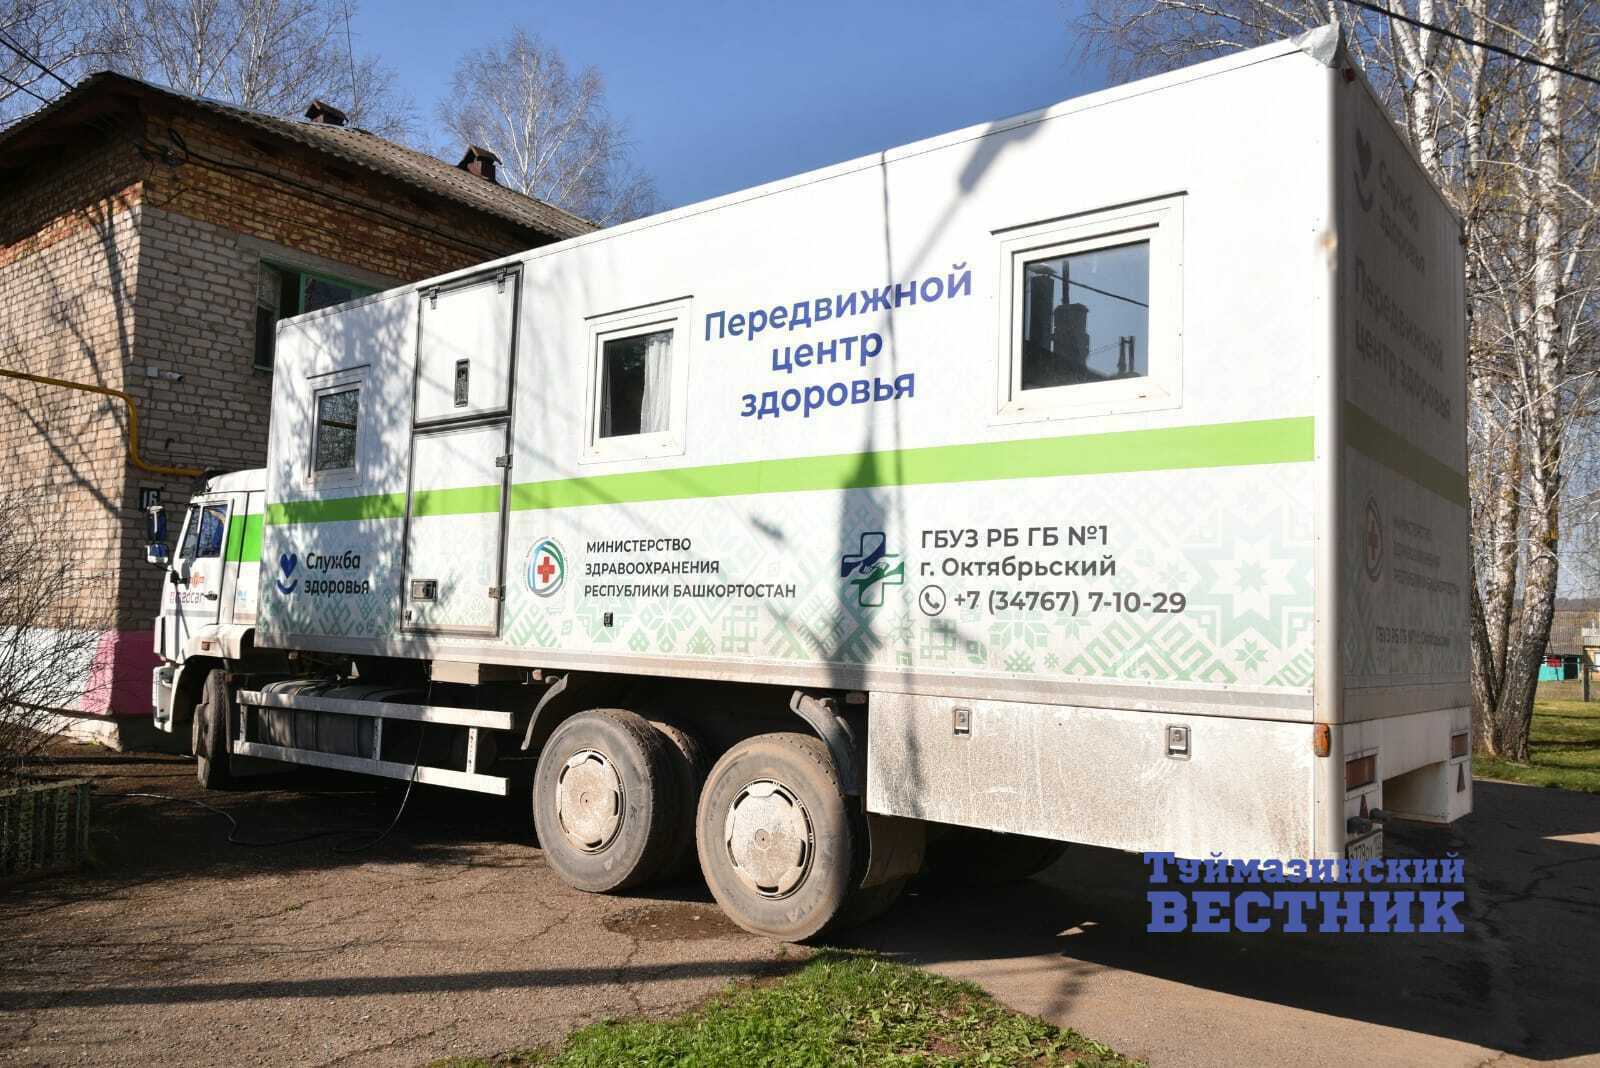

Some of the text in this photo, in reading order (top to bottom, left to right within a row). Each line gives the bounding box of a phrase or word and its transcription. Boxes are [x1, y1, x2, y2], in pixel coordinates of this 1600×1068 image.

[705, 262, 972, 341] Передвижной
[772, 332, 883, 373] центр
[741, 373, 915, 419] здоровья
[586, 538, 692, 554] МИНИСТЕРСТВО
[921, 525, 1108, 548] ГБУЗ РБ ГБ №1
[306, 551, 361, 571] Служба
[585, 560, 720, 577] ЗДРАВООХРАНЕНИЯ
[920, 555, 1116, 580] г. Октябрьский
[304, 577, 369, 597] здоровья
[584, 583, 796, 599] РЕСПУБЛИКИ БАШКОРТОСТАН
[954, 590, 1187, 616] +7 (34767) 7-10-29
